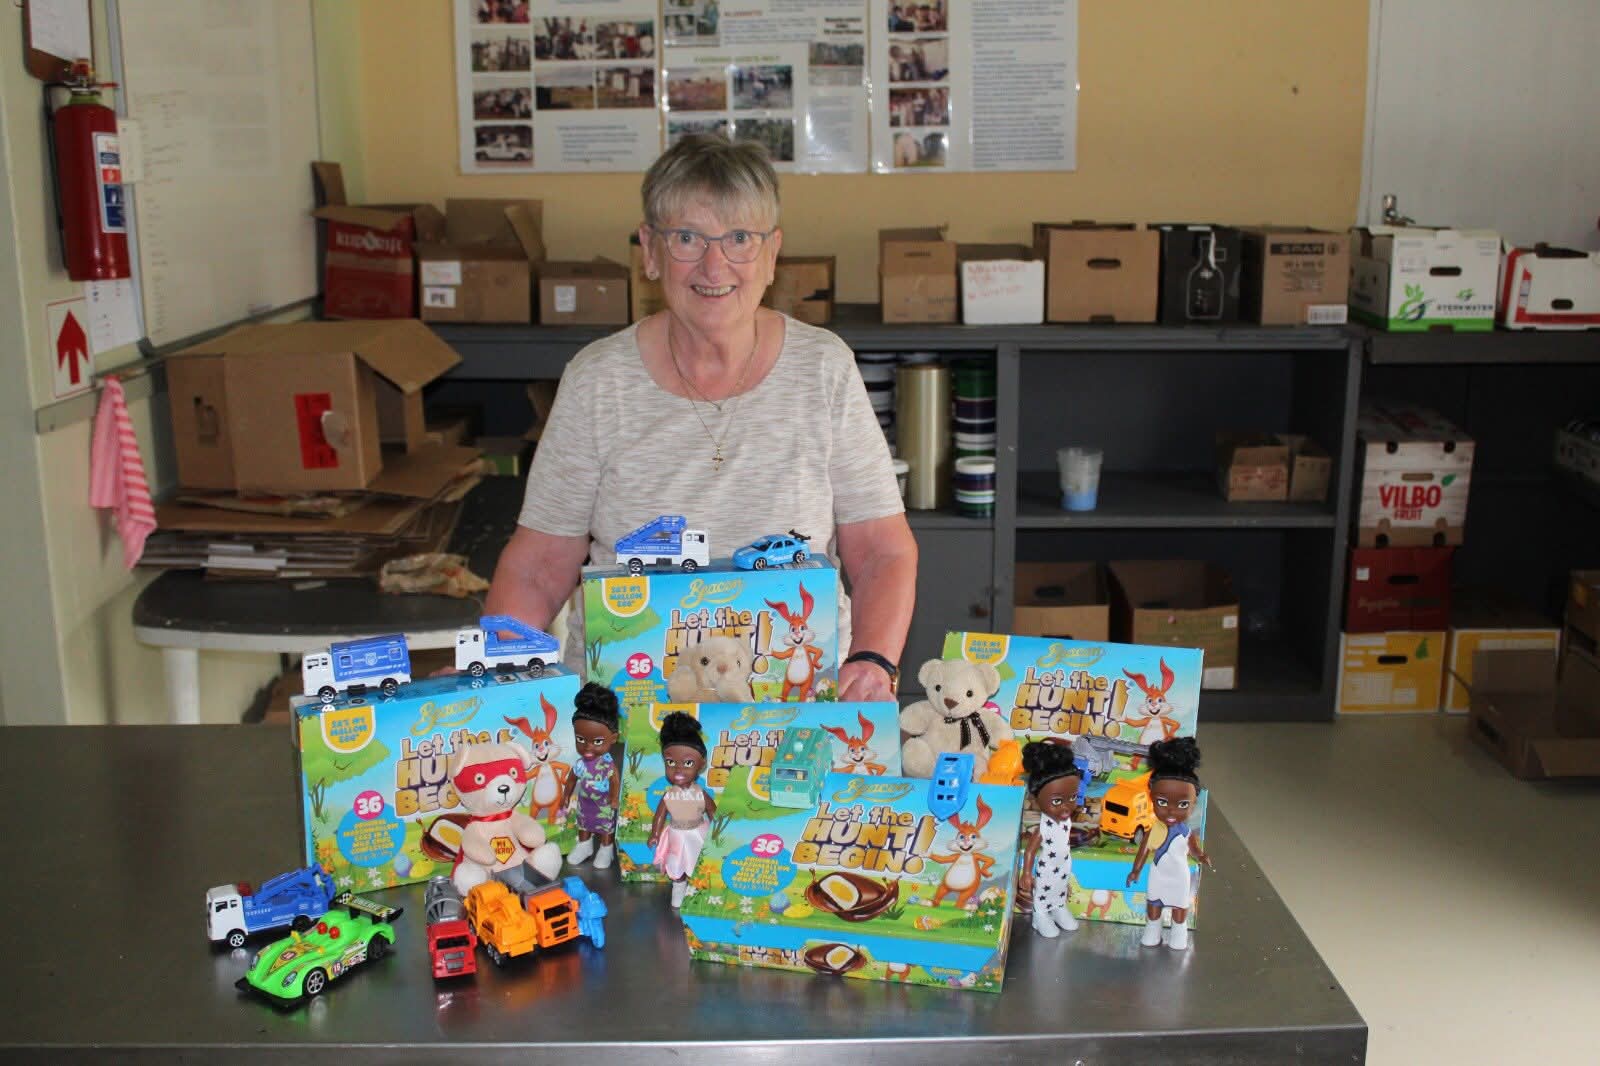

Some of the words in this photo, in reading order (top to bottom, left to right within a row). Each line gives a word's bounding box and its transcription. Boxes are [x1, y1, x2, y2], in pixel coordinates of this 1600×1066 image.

[1379, 484, 1441, 509] VILBO
[1393, 509, 1423, 520] FRUIT
[680, 577, 746, 608] Beacon
[671, 608, 709, 630] Let
[715, 606, 752, 627] the
[629, 659, 650, 674] 36
[1025, 666, 1064, 688] Let
[1071, 669, 1108, 691] the
[1015, 683, 1111, 715] HUNT
[409, 696, 484, 736] Beacon
[401, 734, 445, 760] Let
[451, 729, 491, 754] the
[720, 730, 761, 747] Let
[832, 777, 916, 802] Beacon
[357, 796, 382, 815] 36
[816, 802, 864, 823] Let
[869, 805, 914, 827] the
[802, 818, 916, 848] HUNT
[753, 838, 782, 854] 36
